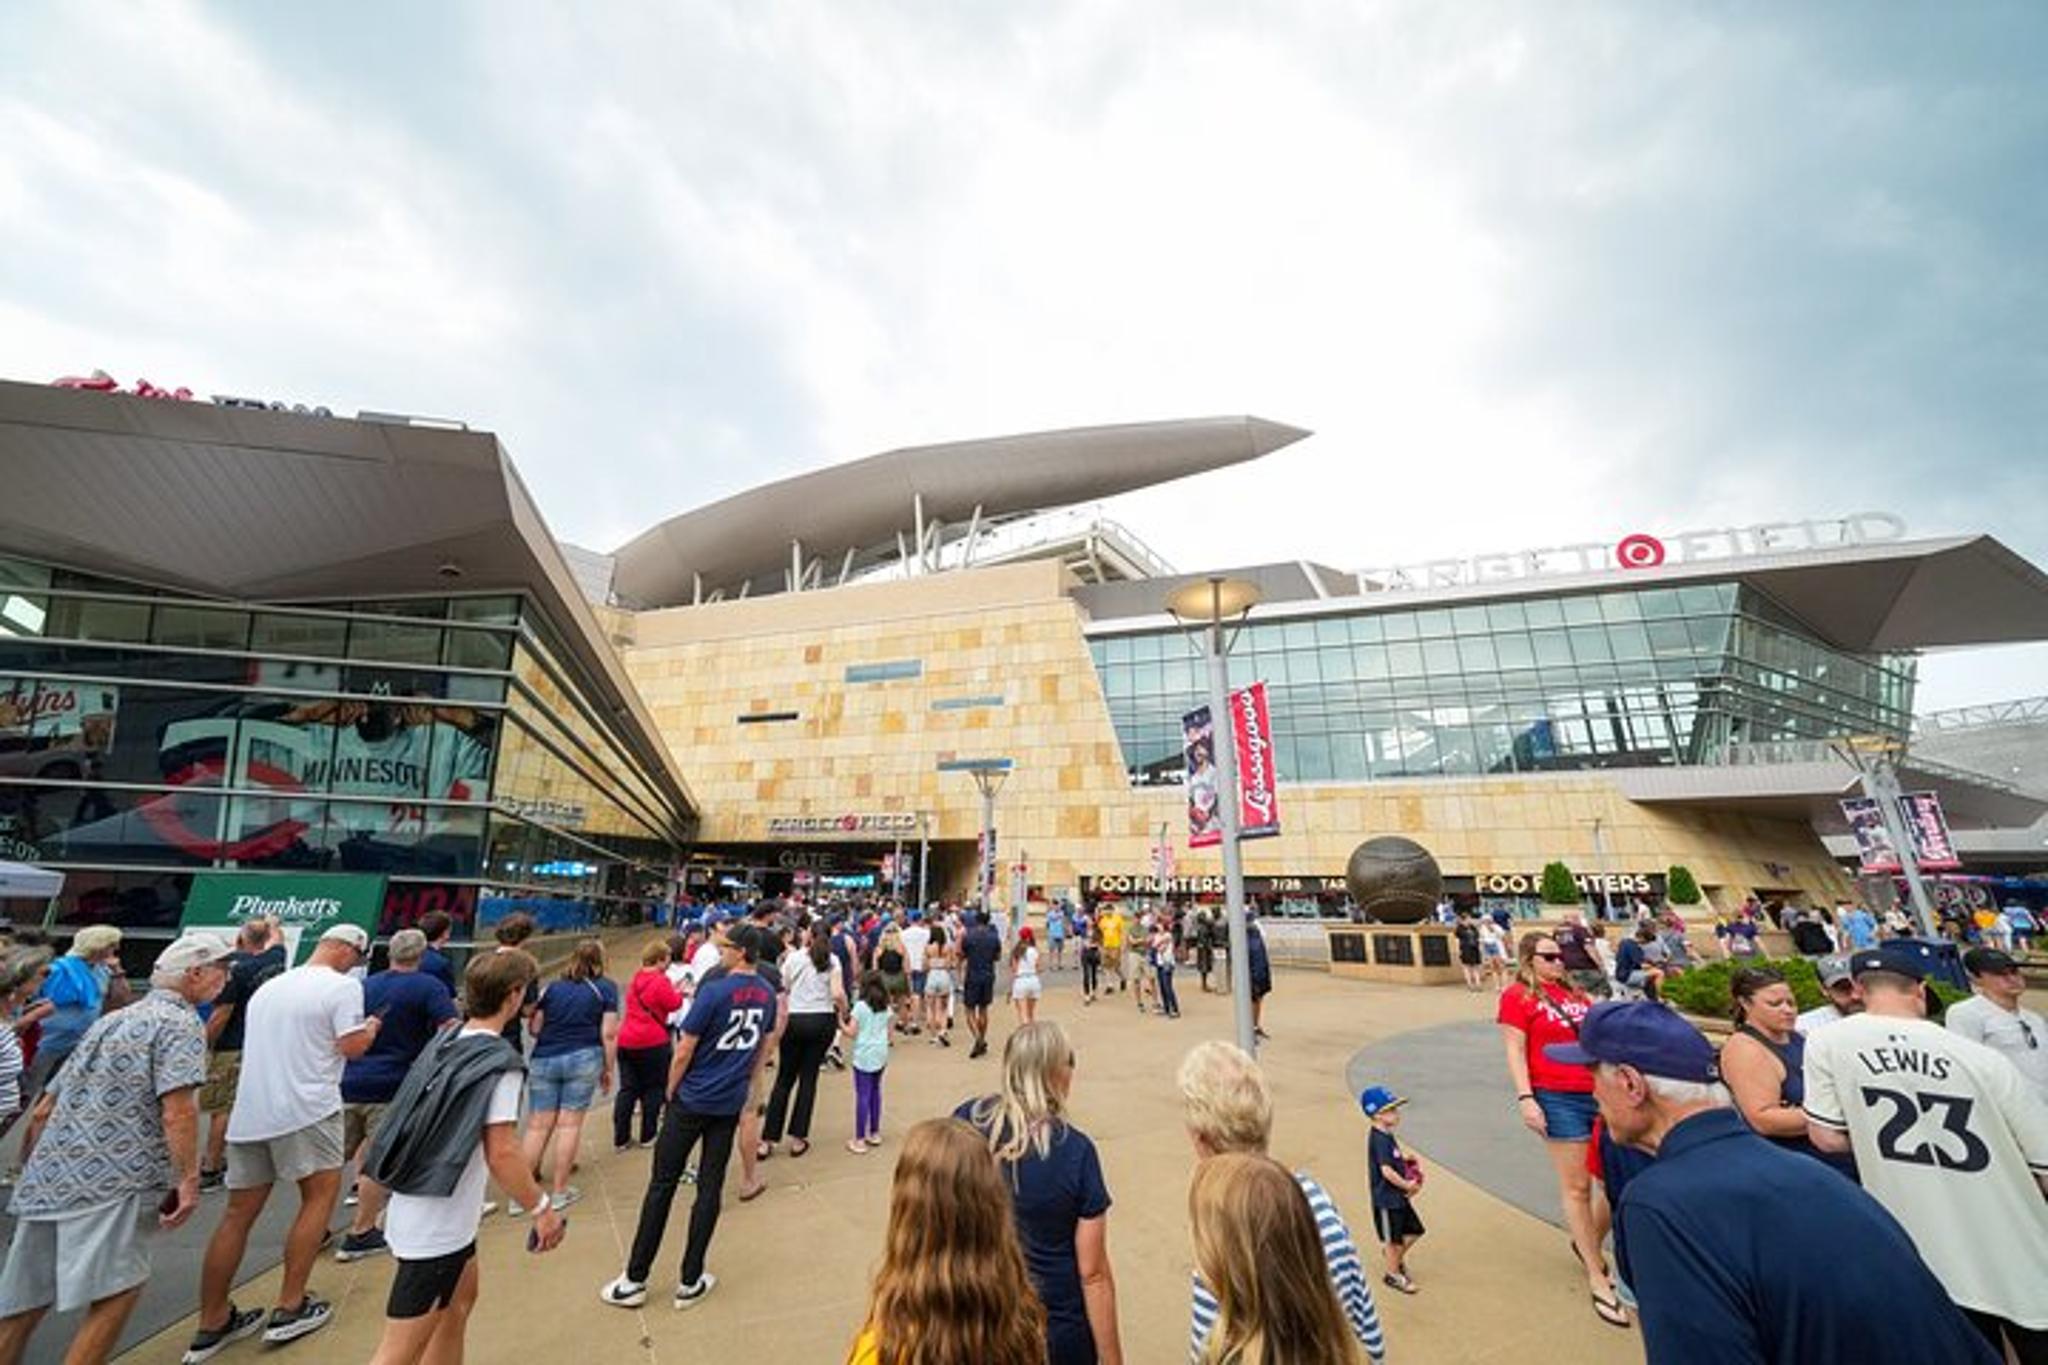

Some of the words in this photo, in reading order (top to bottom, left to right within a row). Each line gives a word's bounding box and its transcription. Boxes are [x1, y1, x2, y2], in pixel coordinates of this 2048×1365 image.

[1680, 511, 1906, 563] FIELD
[302, 757, 421, 791] MINNESOT
[779, 849, 836, 869] GATE
[1475, 875, 1528, 893] FOO
[1532, 875, 1651, 893] FHTERS
[227, 895, 342, 919] Plunkett's
[716, 1008, 764, 1050] 25
[1858, 1048, 1951, 1080] LEWIS
[1860, 1086, 1990, 1172] 23
